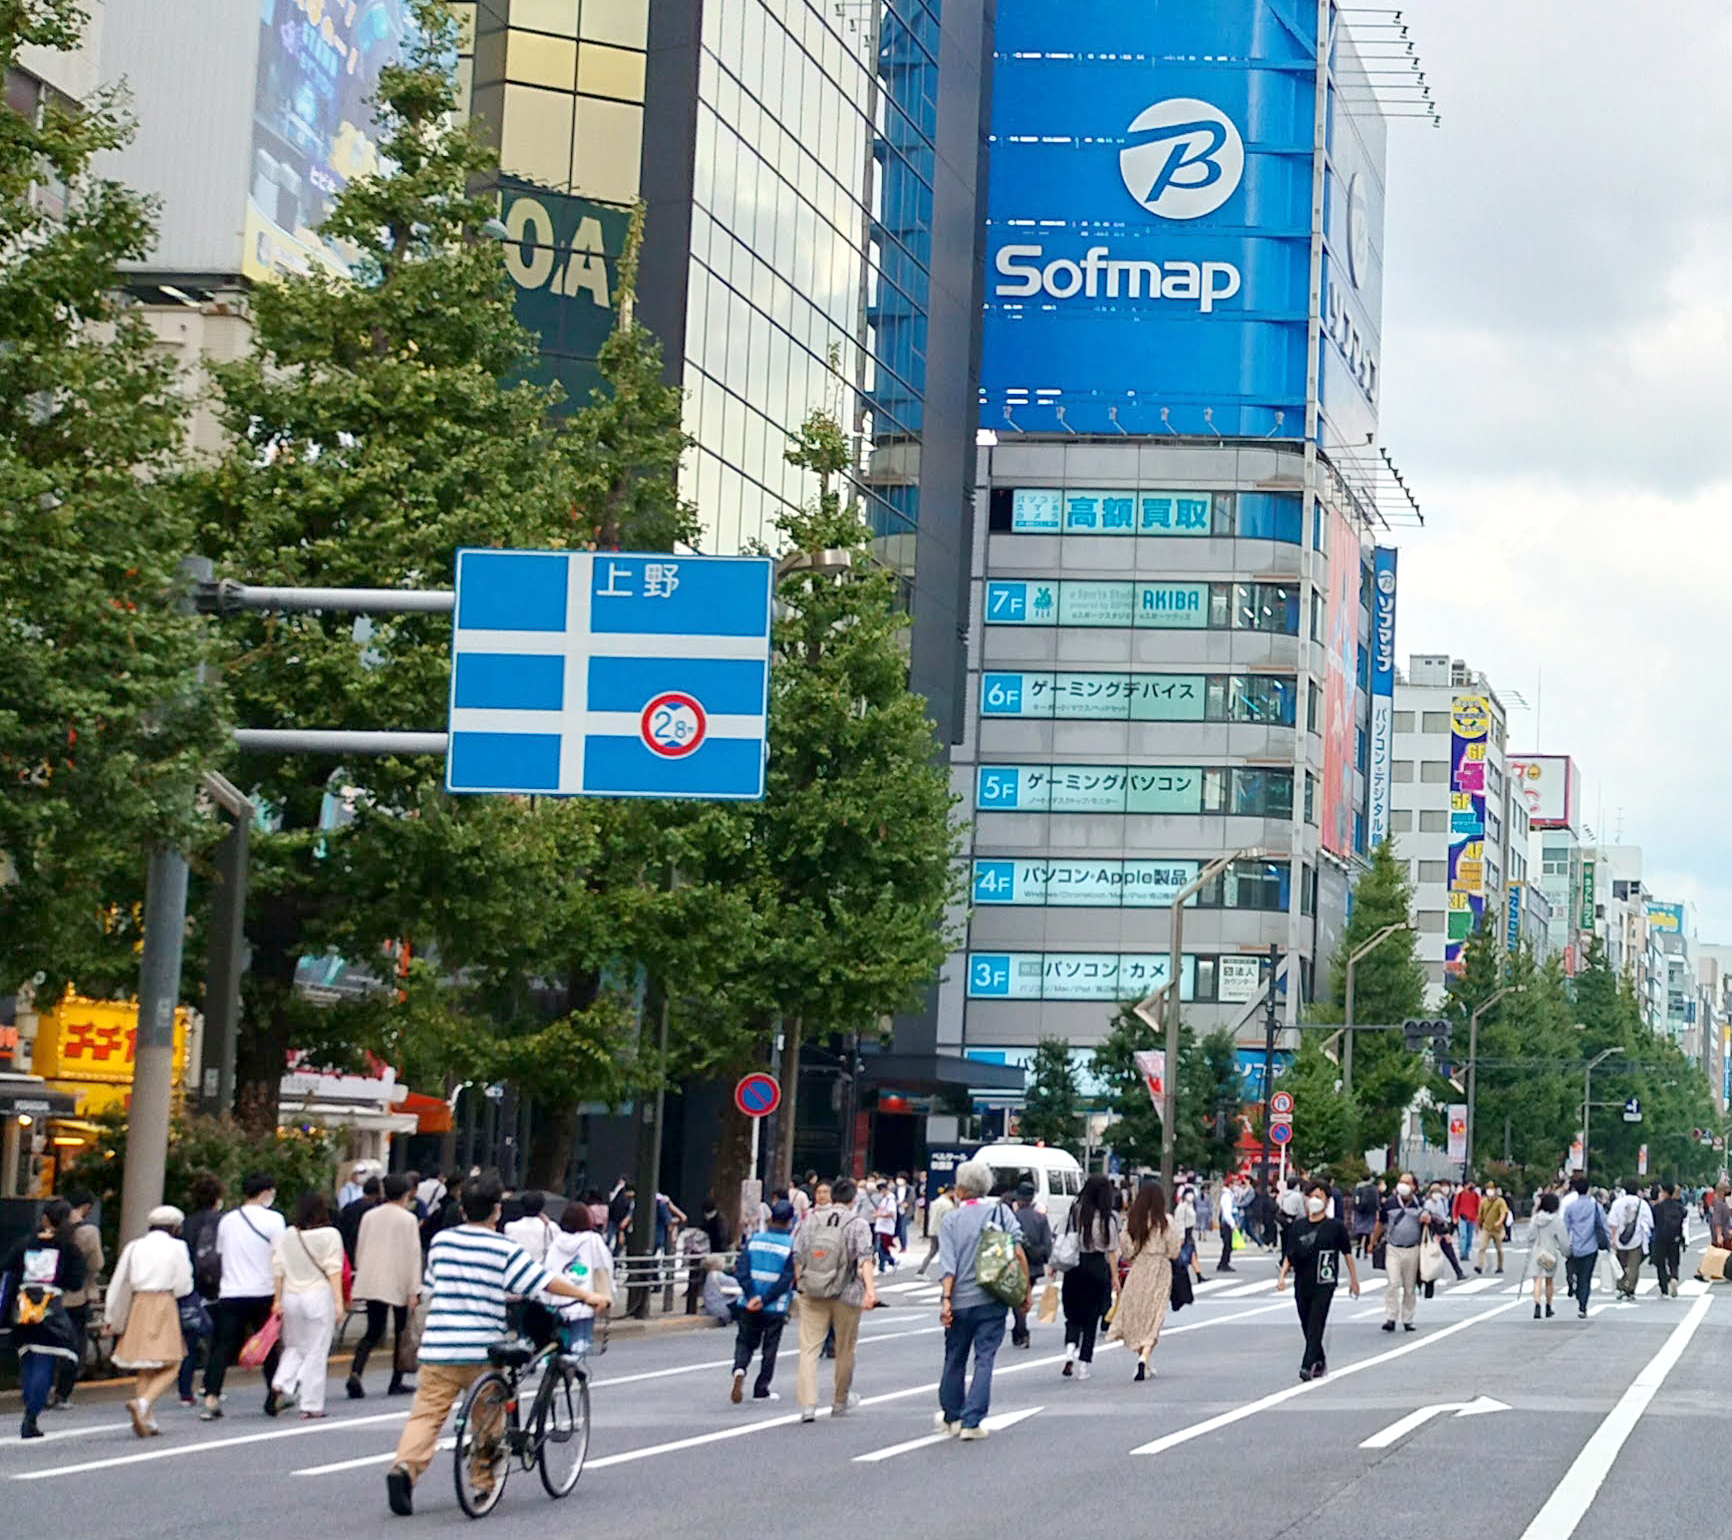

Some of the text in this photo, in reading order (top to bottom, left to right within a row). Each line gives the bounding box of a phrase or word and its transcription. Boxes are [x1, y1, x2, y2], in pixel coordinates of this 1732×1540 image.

[995, 244, 1241, 313] Sofmap
[1066, 496, 1208, 530] 高額買取
[595, 562, 680, 598] 上野
[992, 590, 1023, 614] 7F
[1143, 589, 1199, 611] AKIBA
[1378, 595, 1395, 673] ソフマップ
[987, 682, 1019, 706] 6F
[1031, 679, 1194, 700] ゲーミングデバイス
[984, 775, 1015, 799] 5F
[1027, 773, 1192, 792] ゲーミングパソコン
[979, 869, 1010, 893] 4F
[975, 963, 1006, 987] 3F
